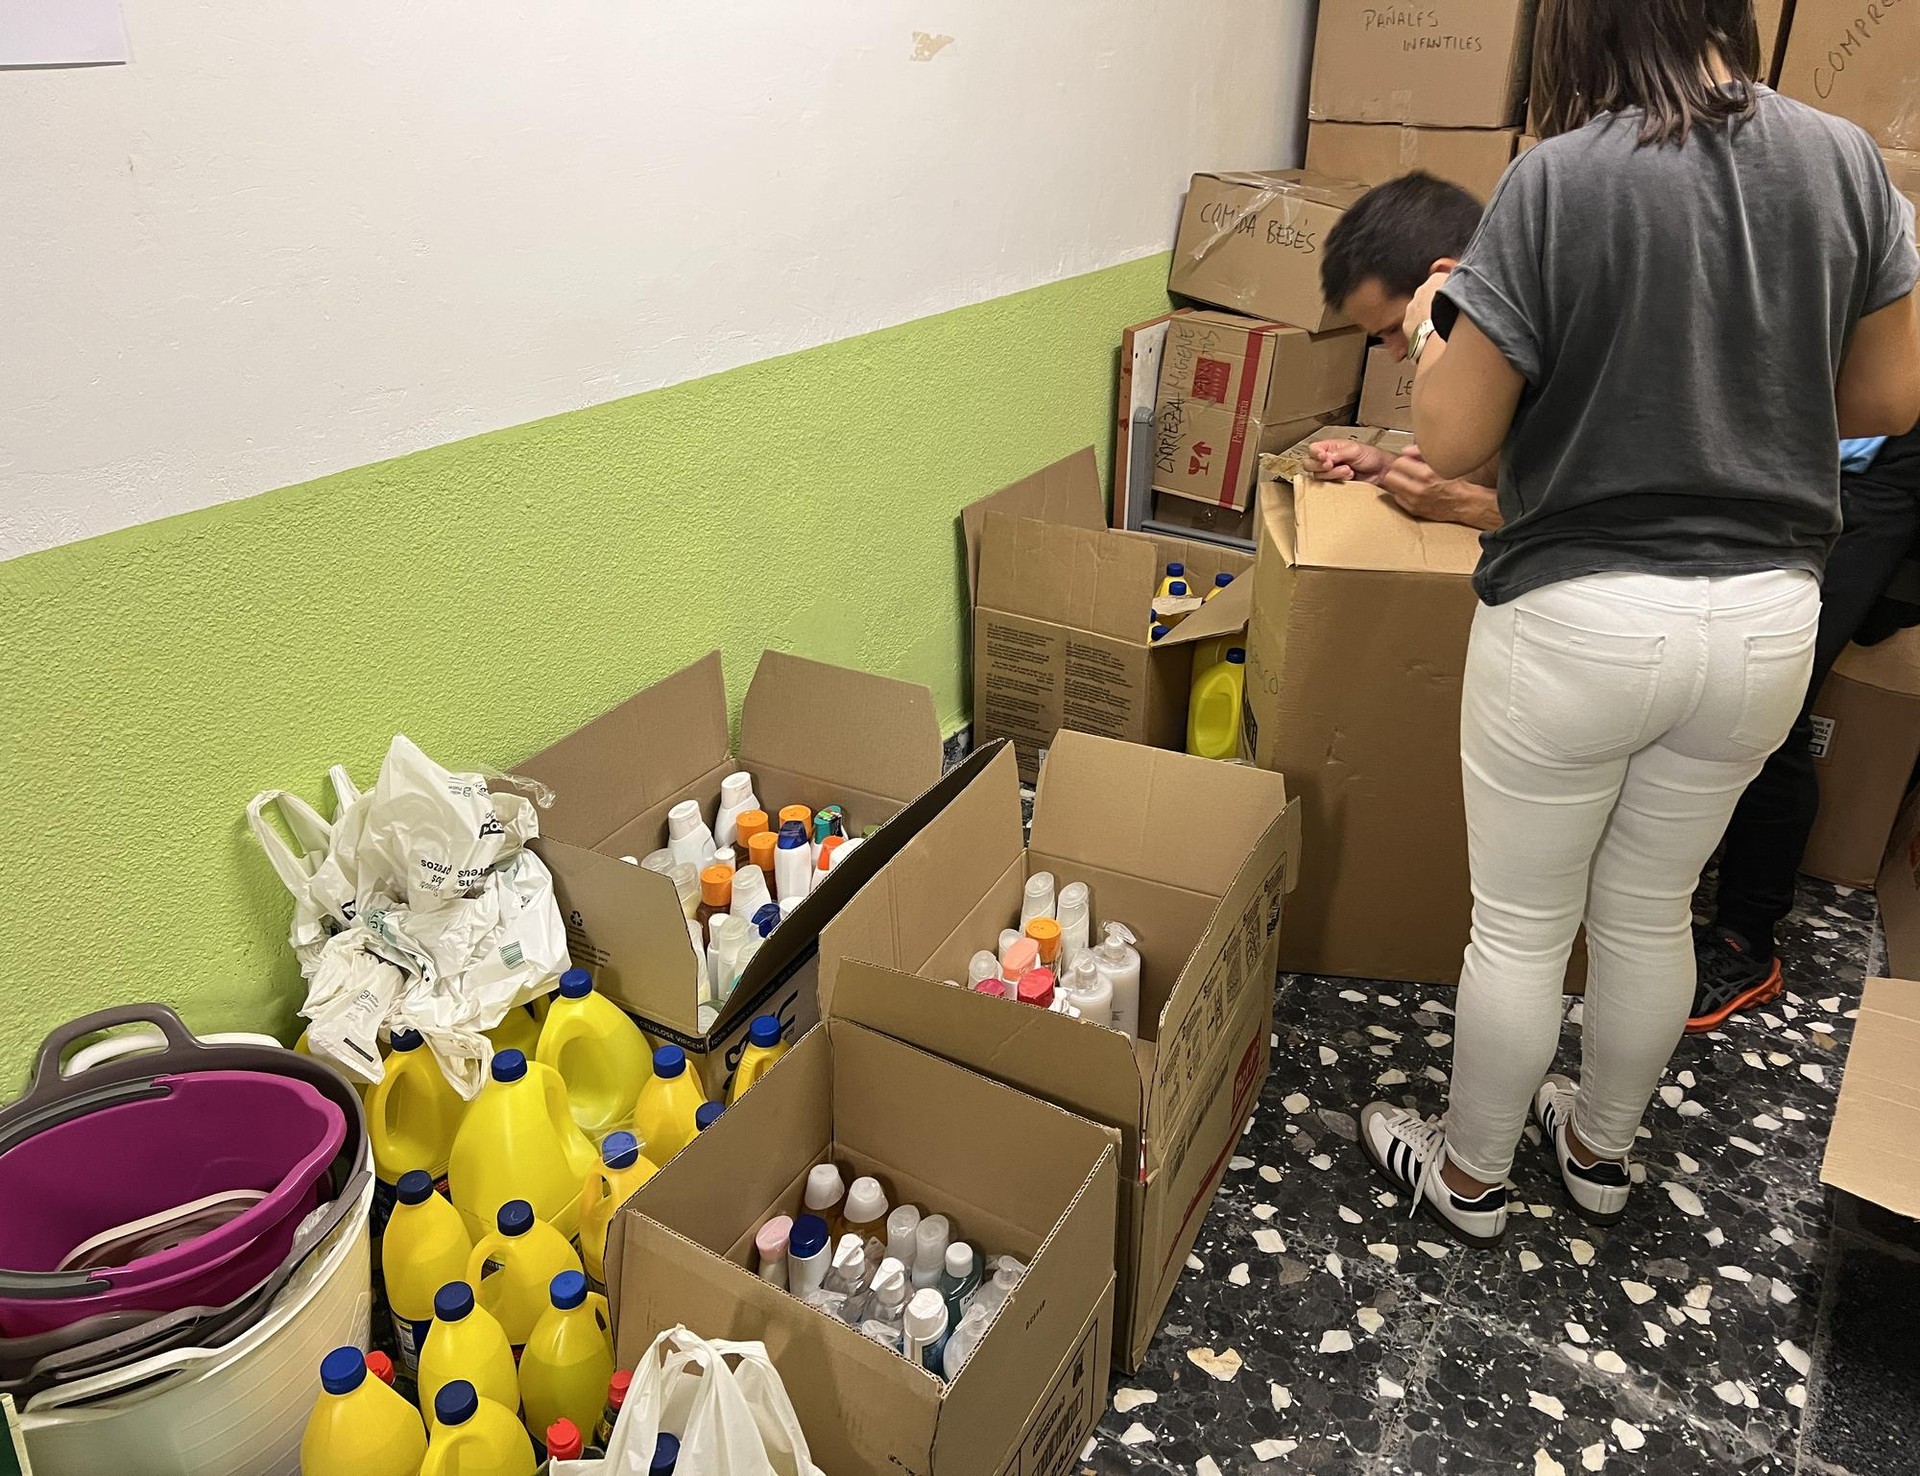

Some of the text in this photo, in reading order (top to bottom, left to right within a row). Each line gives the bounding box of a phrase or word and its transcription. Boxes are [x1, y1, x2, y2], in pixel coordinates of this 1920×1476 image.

[1403, 36, 1483, 52] INFANTILES
[1266, 219, 1316, 254] BEBÉS
[420, 859, 453, 875] prezos
